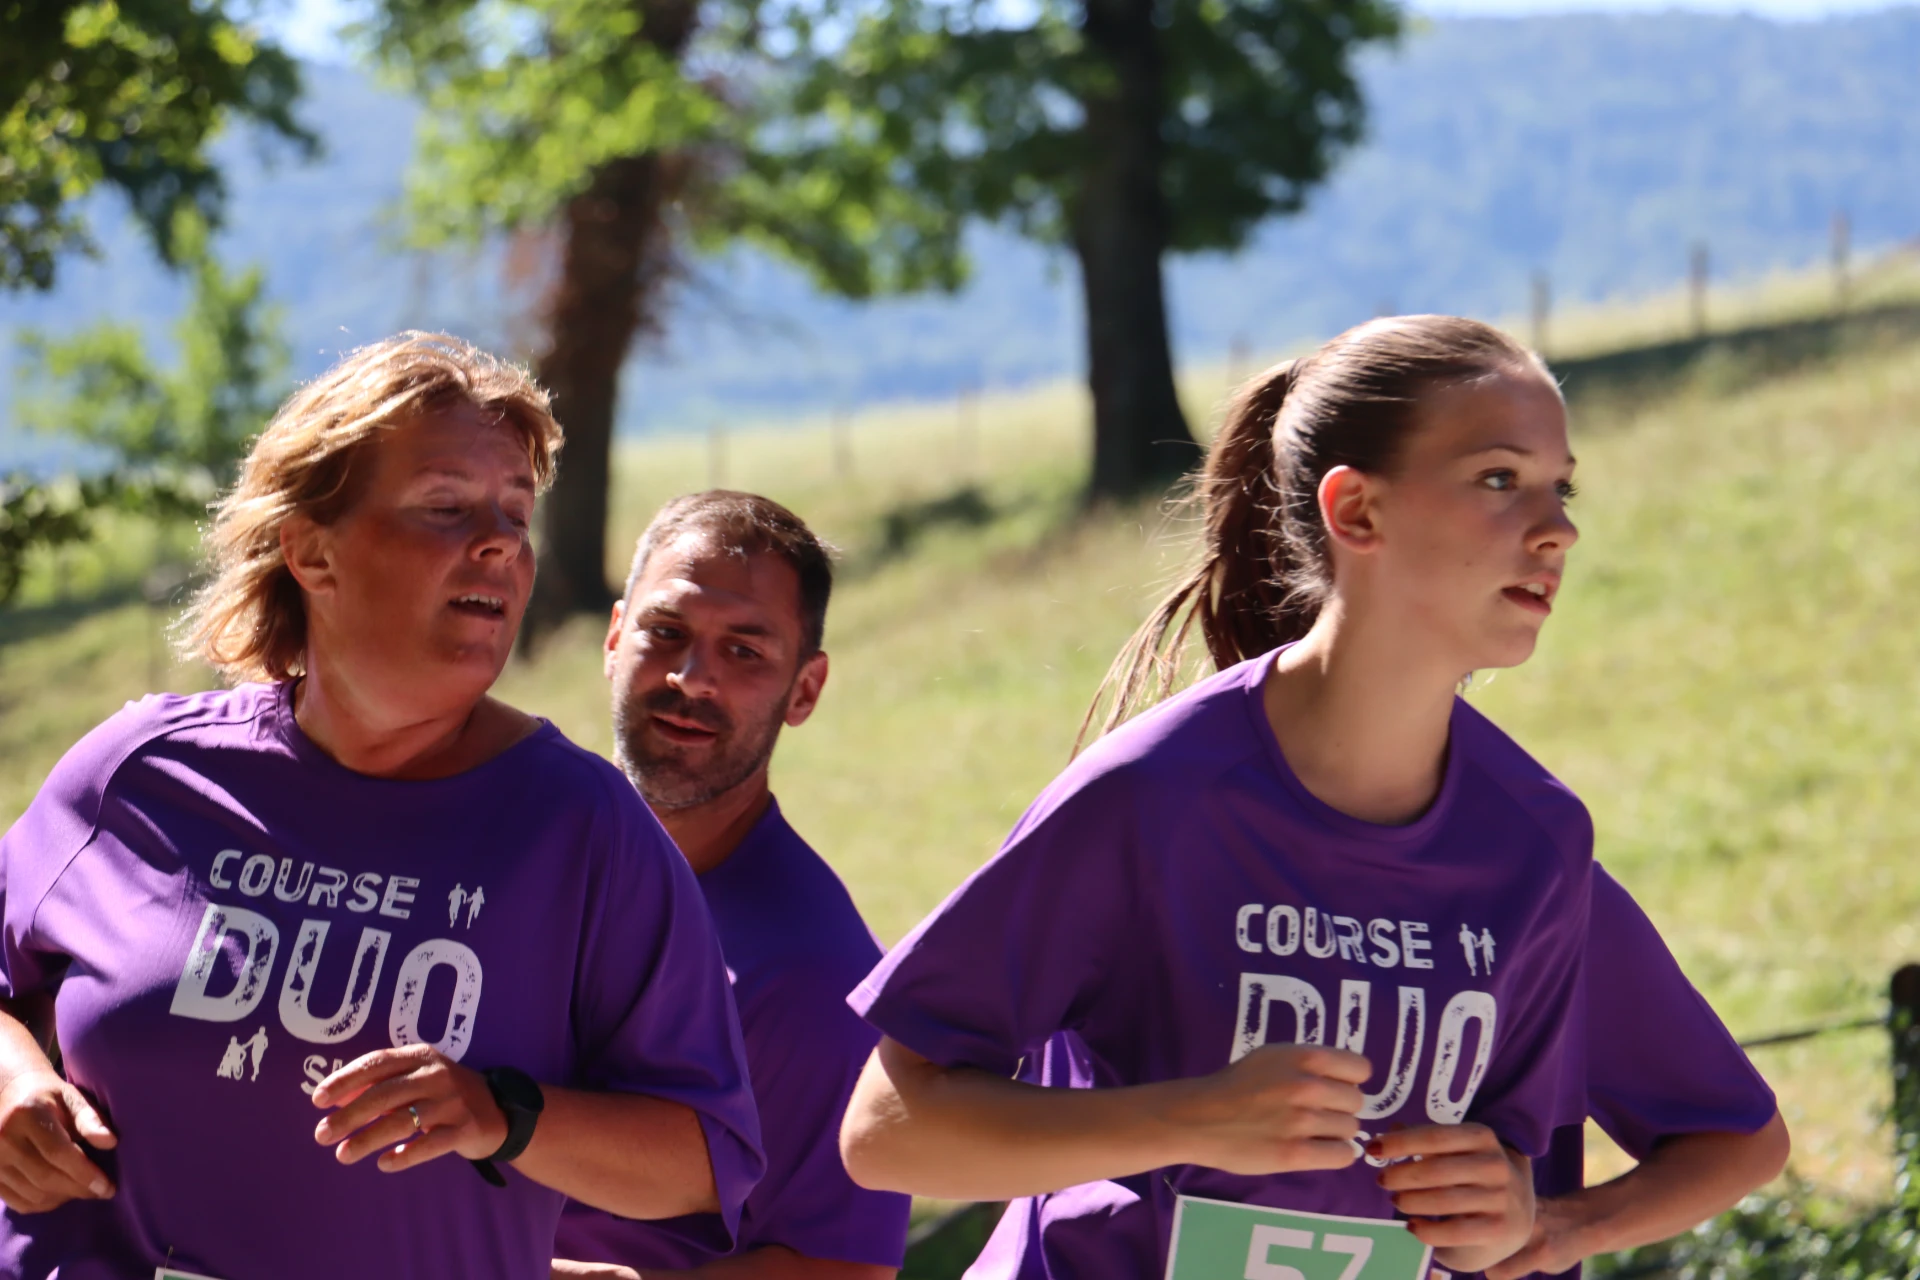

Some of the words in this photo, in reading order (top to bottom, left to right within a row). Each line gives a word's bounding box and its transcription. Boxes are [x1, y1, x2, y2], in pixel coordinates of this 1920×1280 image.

[209, 849, 420, 919] COURSE
[1236, 903, 1434, 969] COURSE
[169, 903, 483, 1063] DUO
[1229, 972, 1496, 1124] DUO
